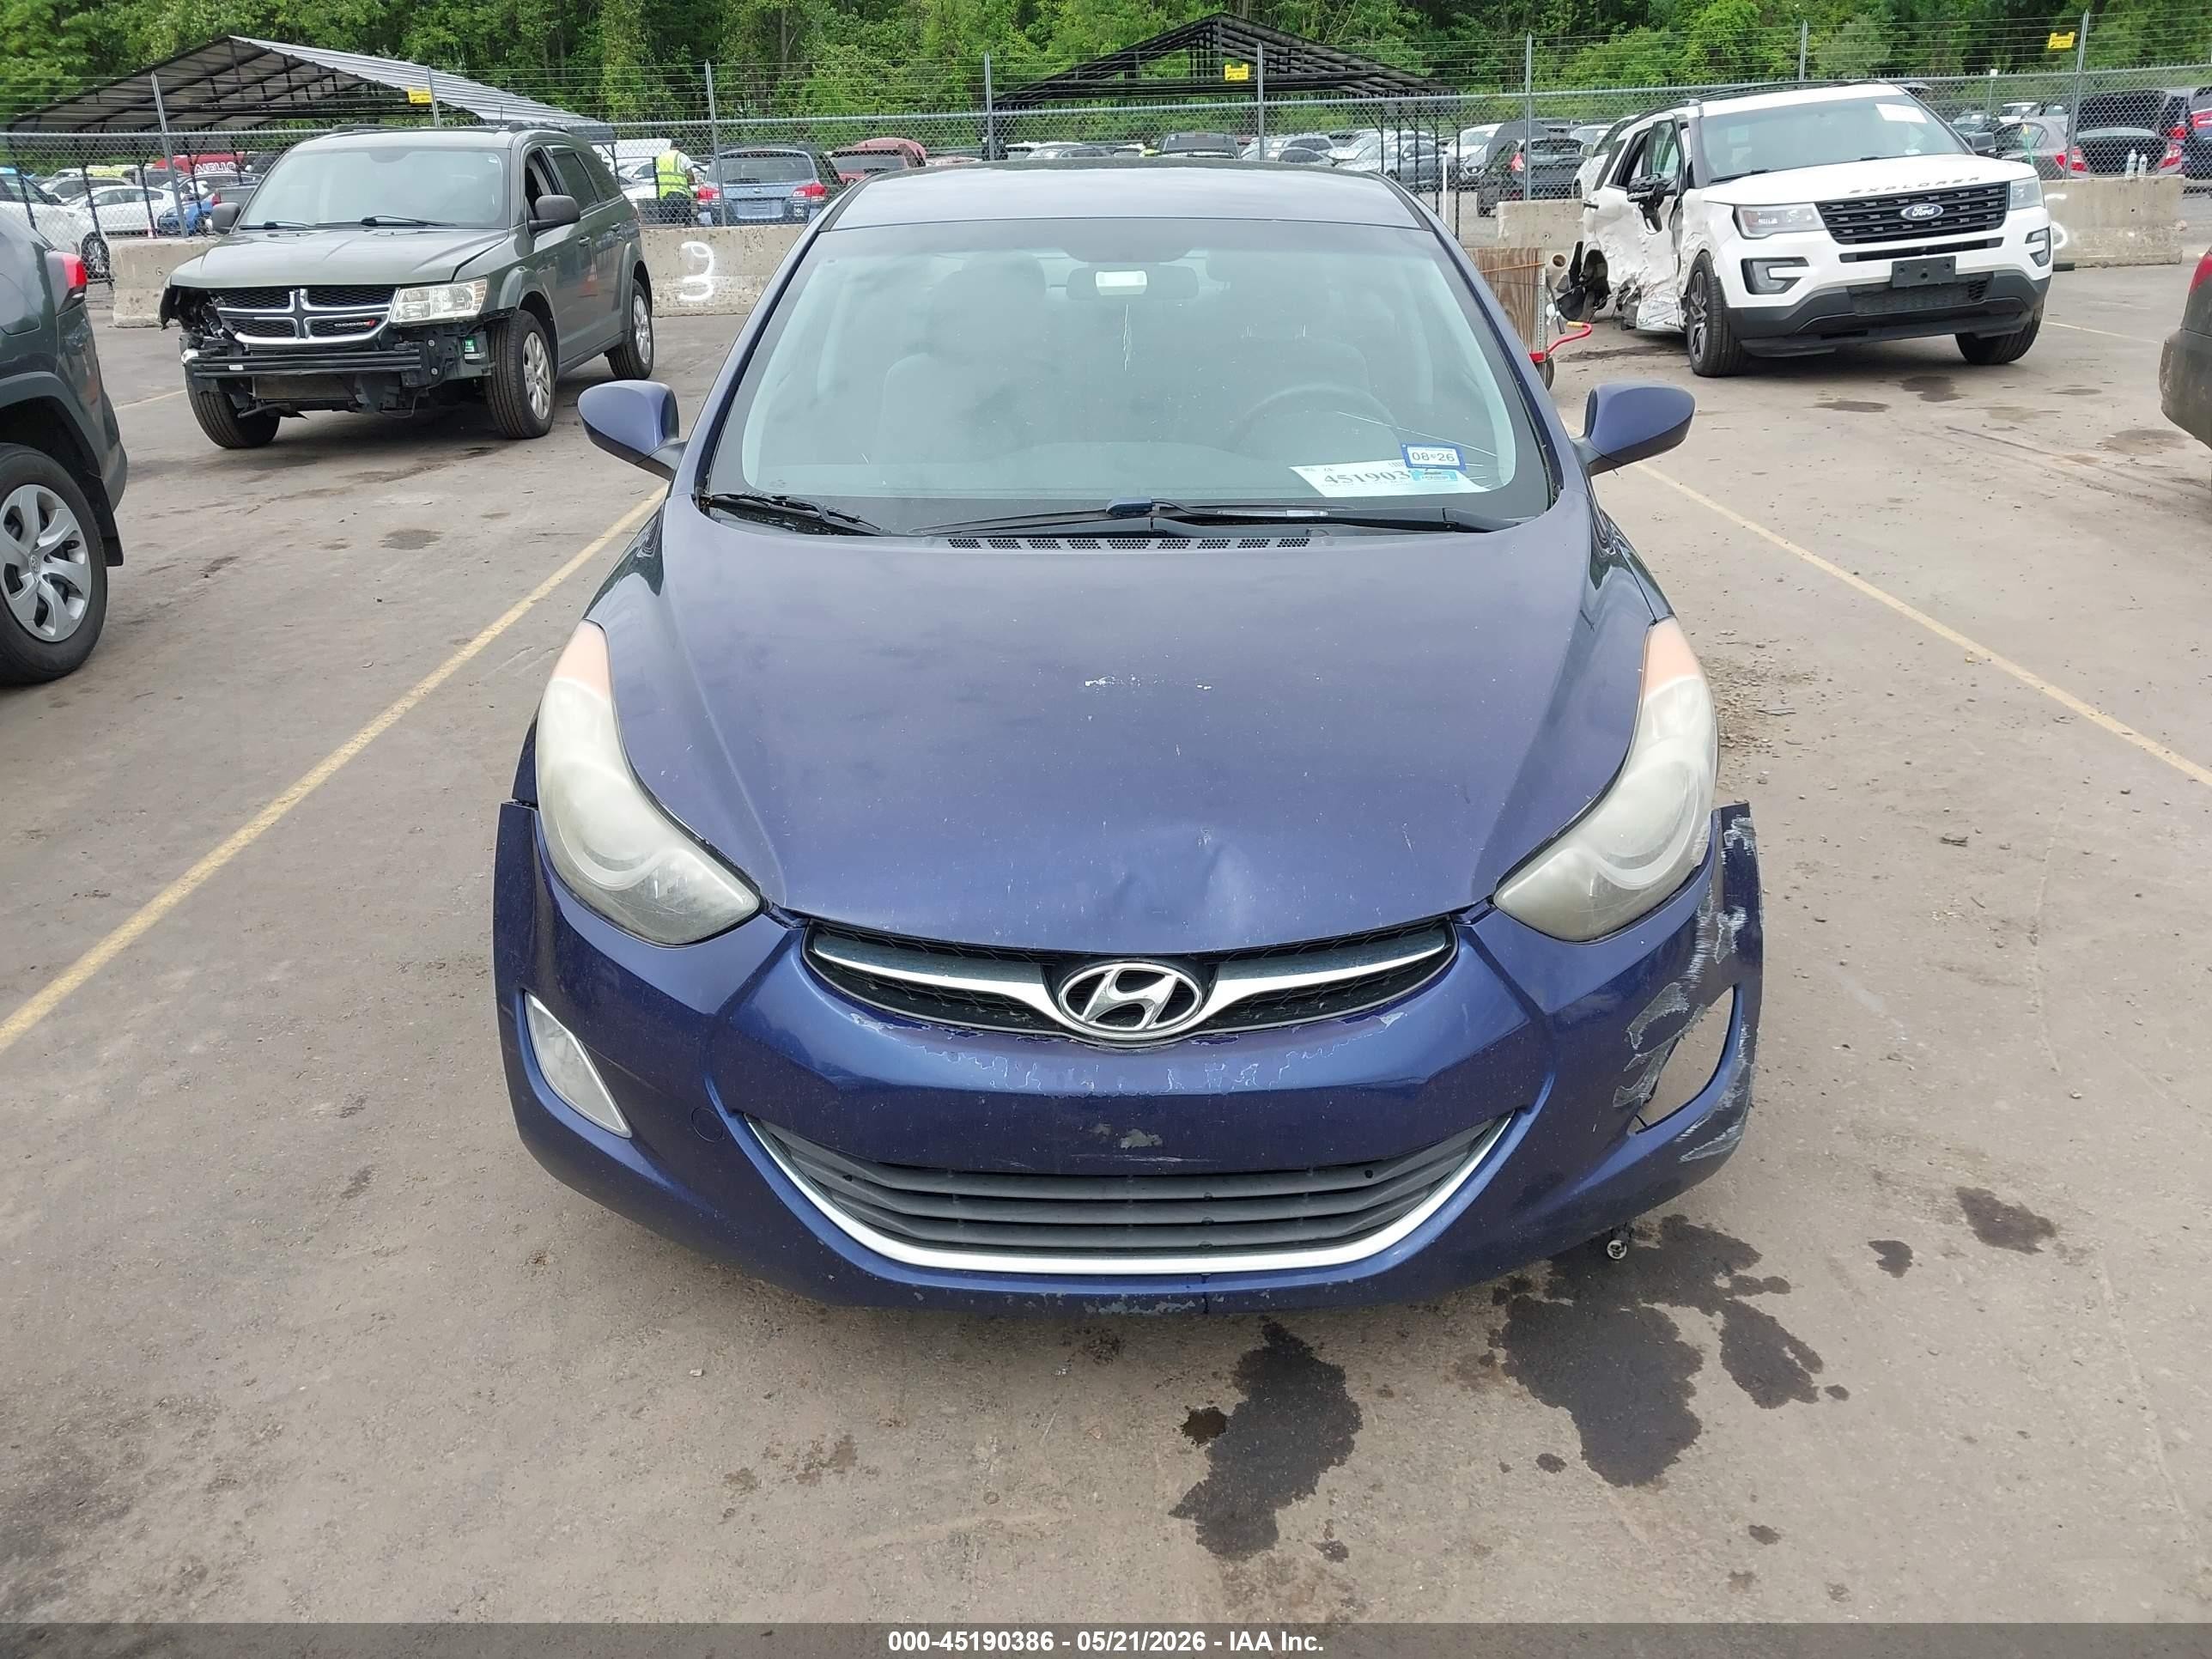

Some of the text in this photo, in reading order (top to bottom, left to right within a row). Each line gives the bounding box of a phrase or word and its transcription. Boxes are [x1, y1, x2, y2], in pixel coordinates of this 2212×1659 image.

[1848, 176, 1980, 194] EXPLORER
[1911, 205, 1935, 216] Ford
[1412, 452, 1455, 462] 08 26
[1324, 470, 1411, 484] 451903
